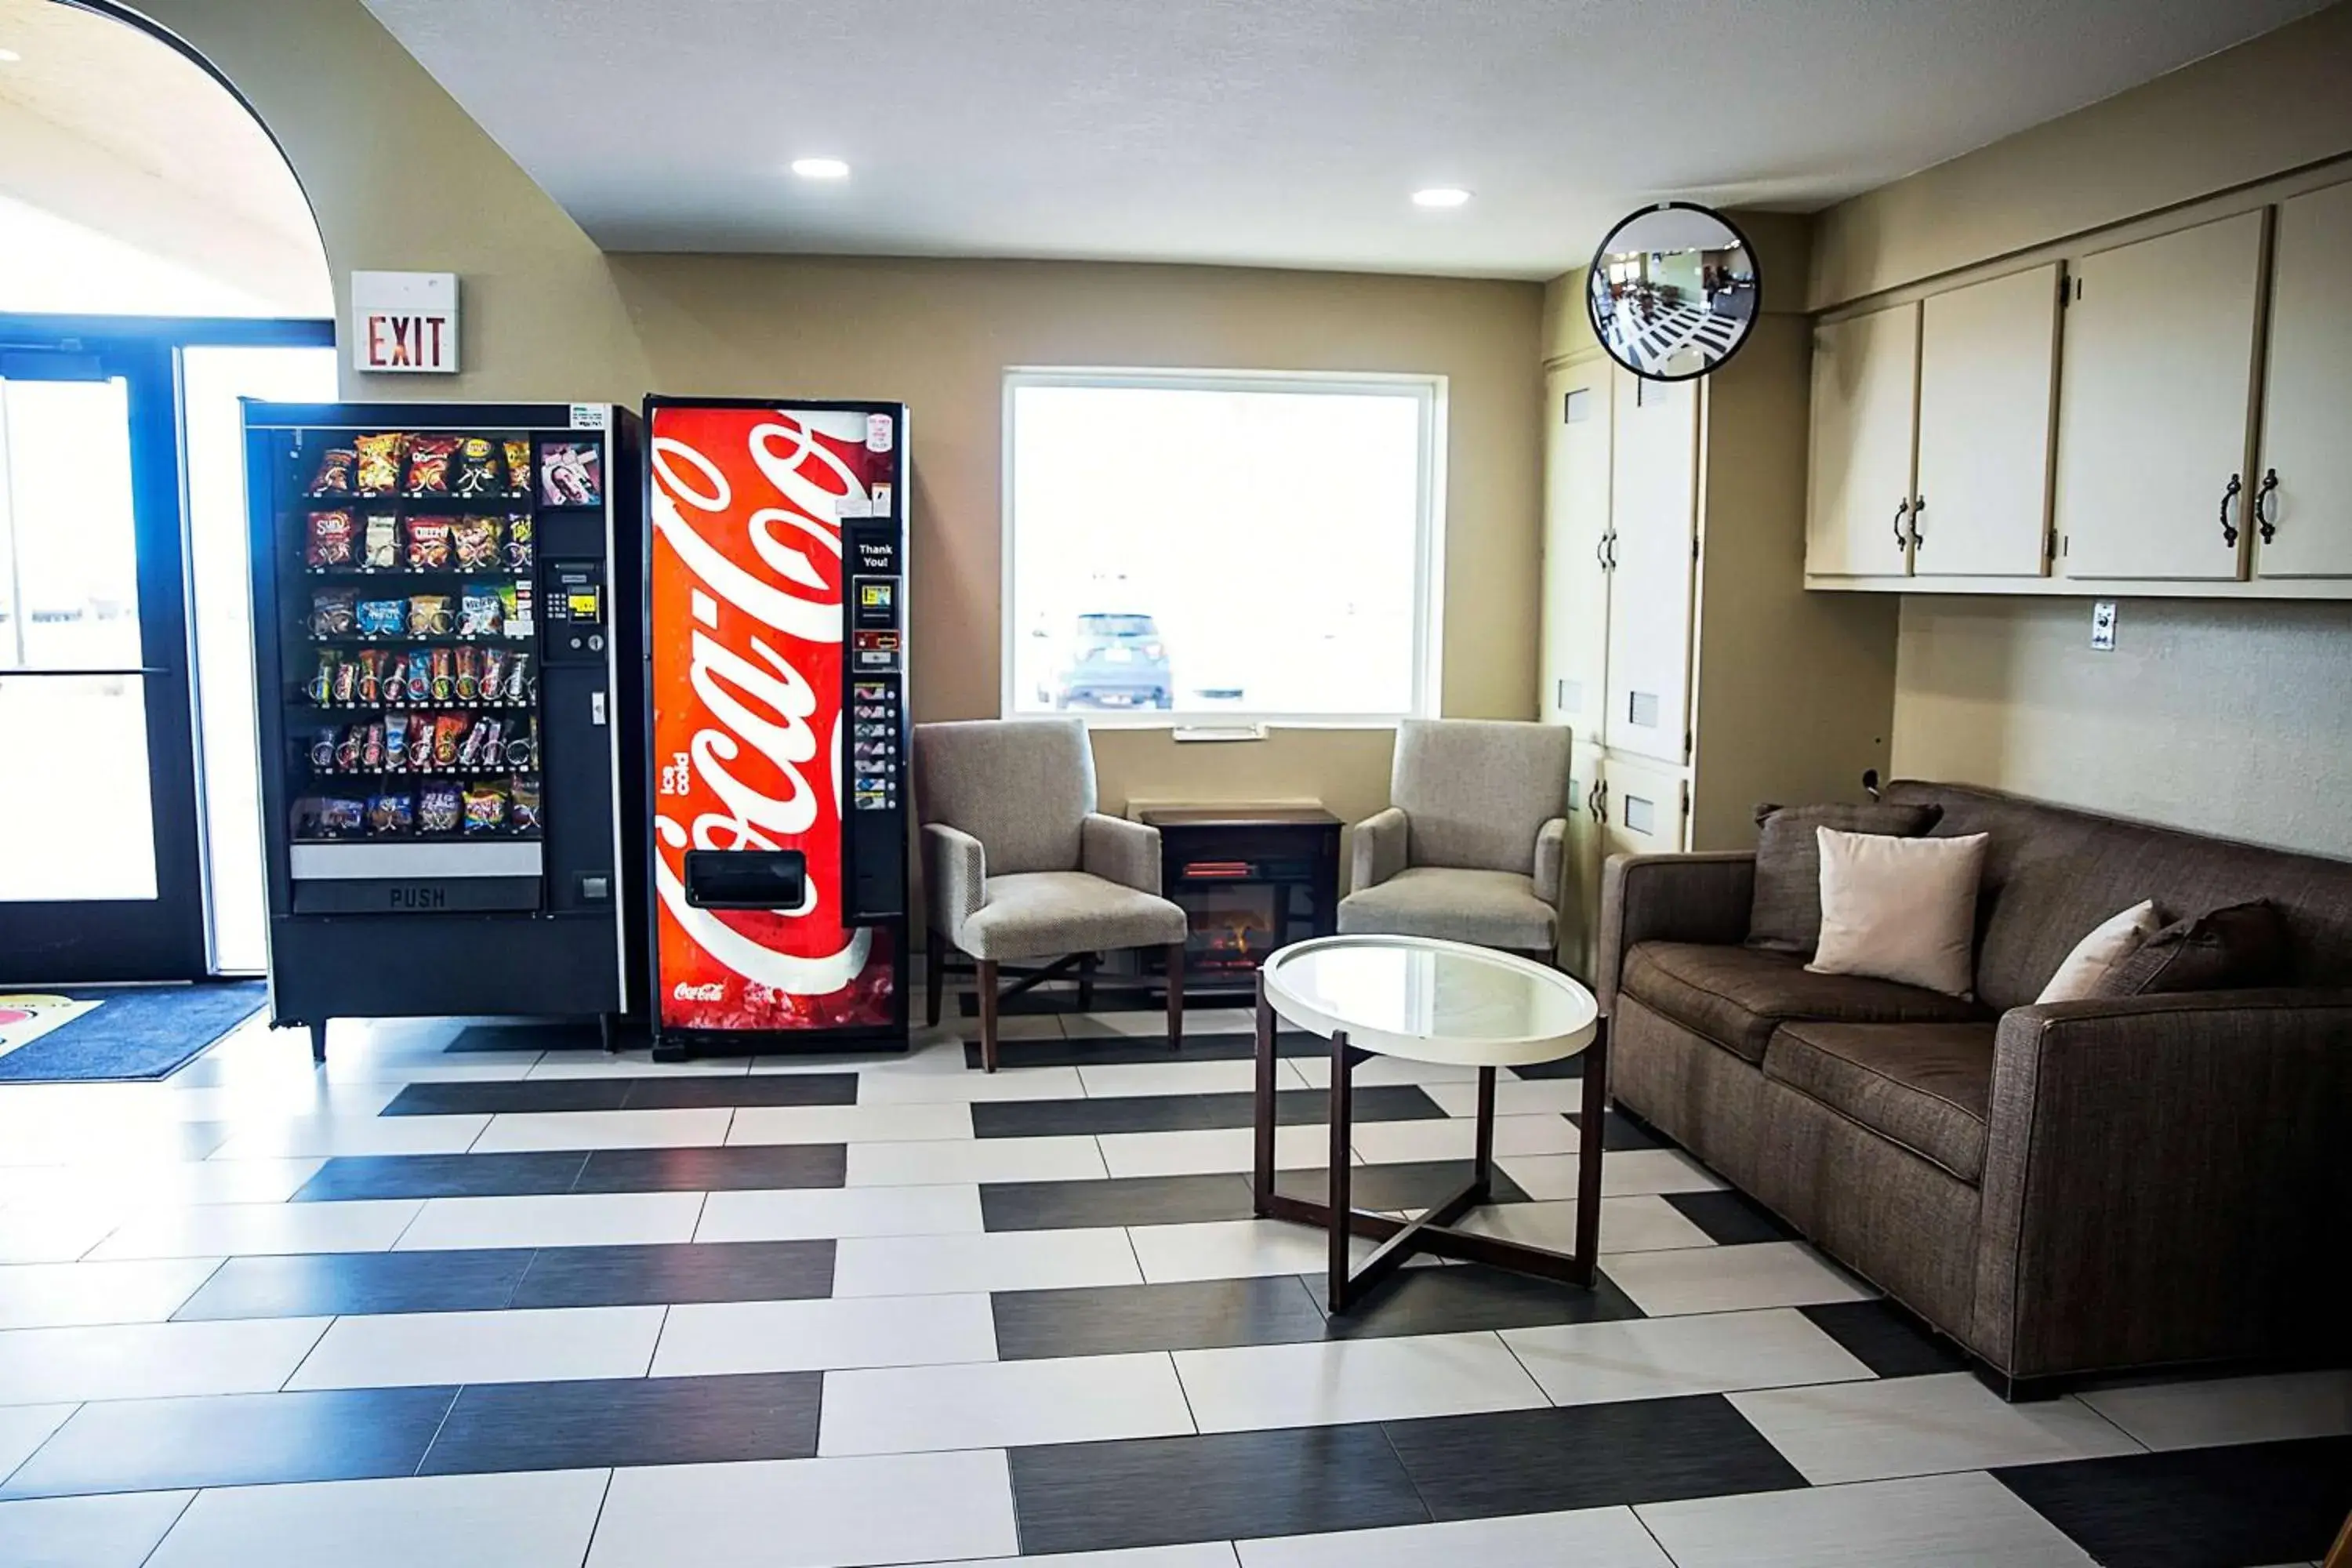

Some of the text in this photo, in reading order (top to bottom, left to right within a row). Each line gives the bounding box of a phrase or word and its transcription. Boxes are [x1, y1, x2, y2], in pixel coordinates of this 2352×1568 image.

[368, 316, 445, 366] EXIT
[858, 544, 893, 555] Thank
[863, 557, 888, 567] You!
[392, 889, 444, 907] PUSH
